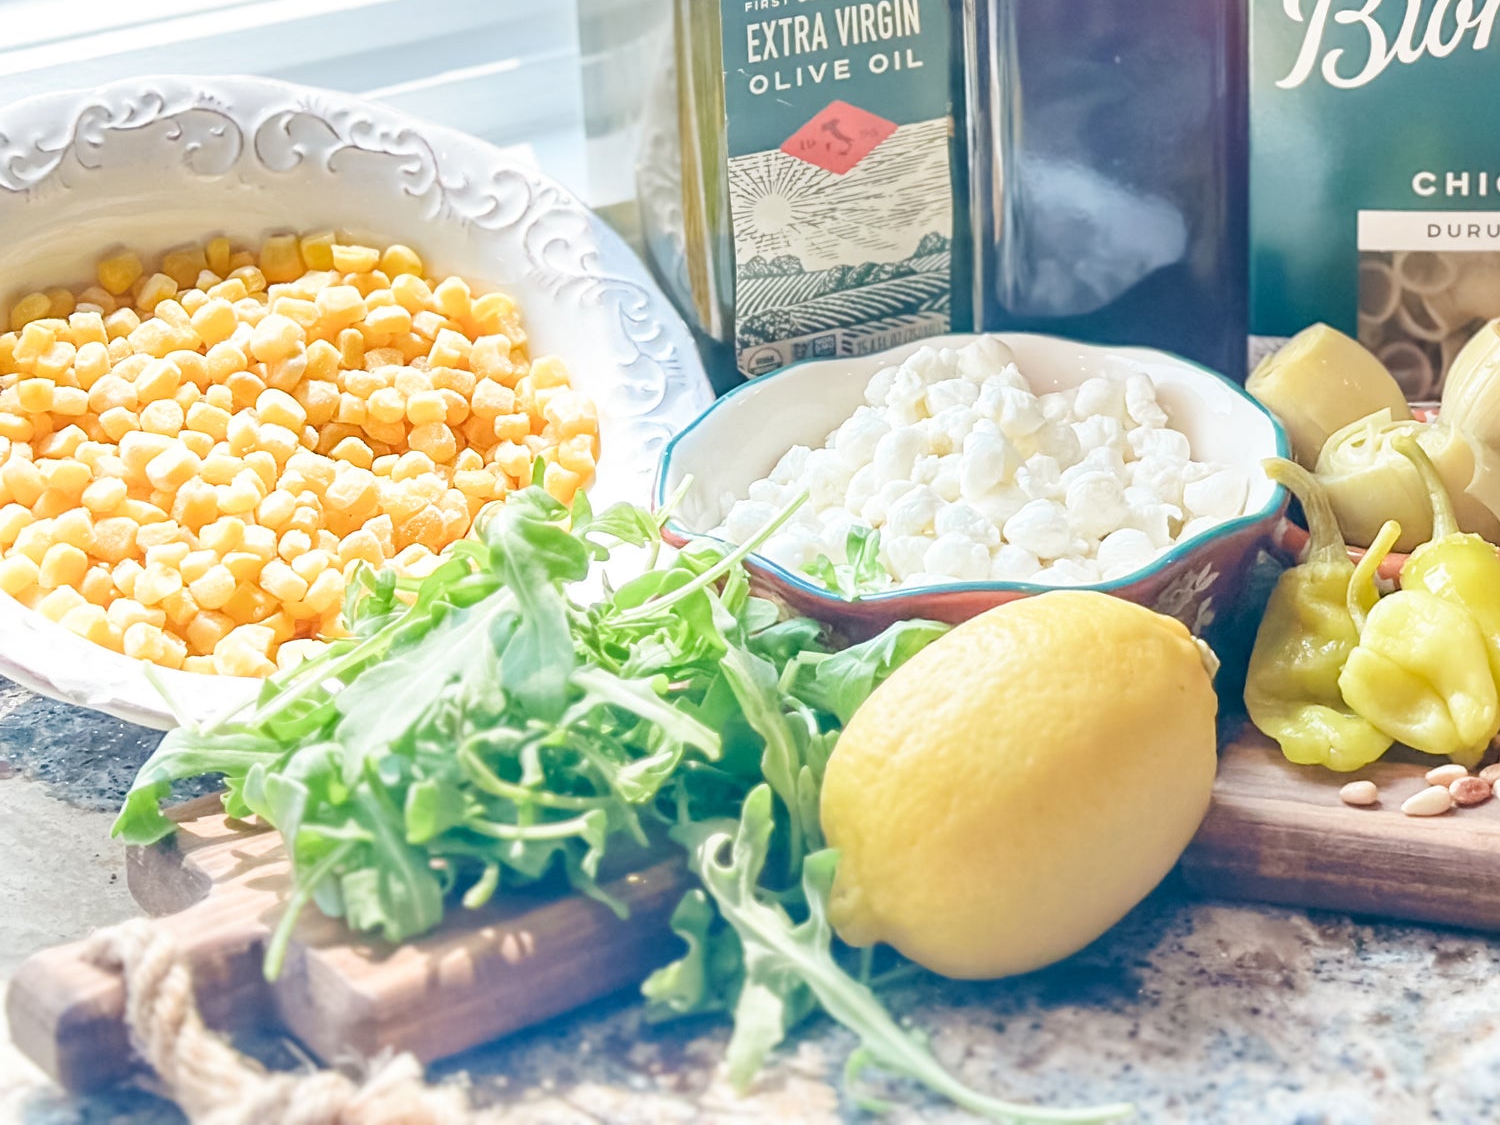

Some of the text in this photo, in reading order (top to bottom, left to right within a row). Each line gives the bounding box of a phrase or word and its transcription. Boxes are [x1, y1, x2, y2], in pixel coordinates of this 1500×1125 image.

[746, 12, 829, 63] EXTRA
[749, 48, 923, 95] OLIVE OIL
